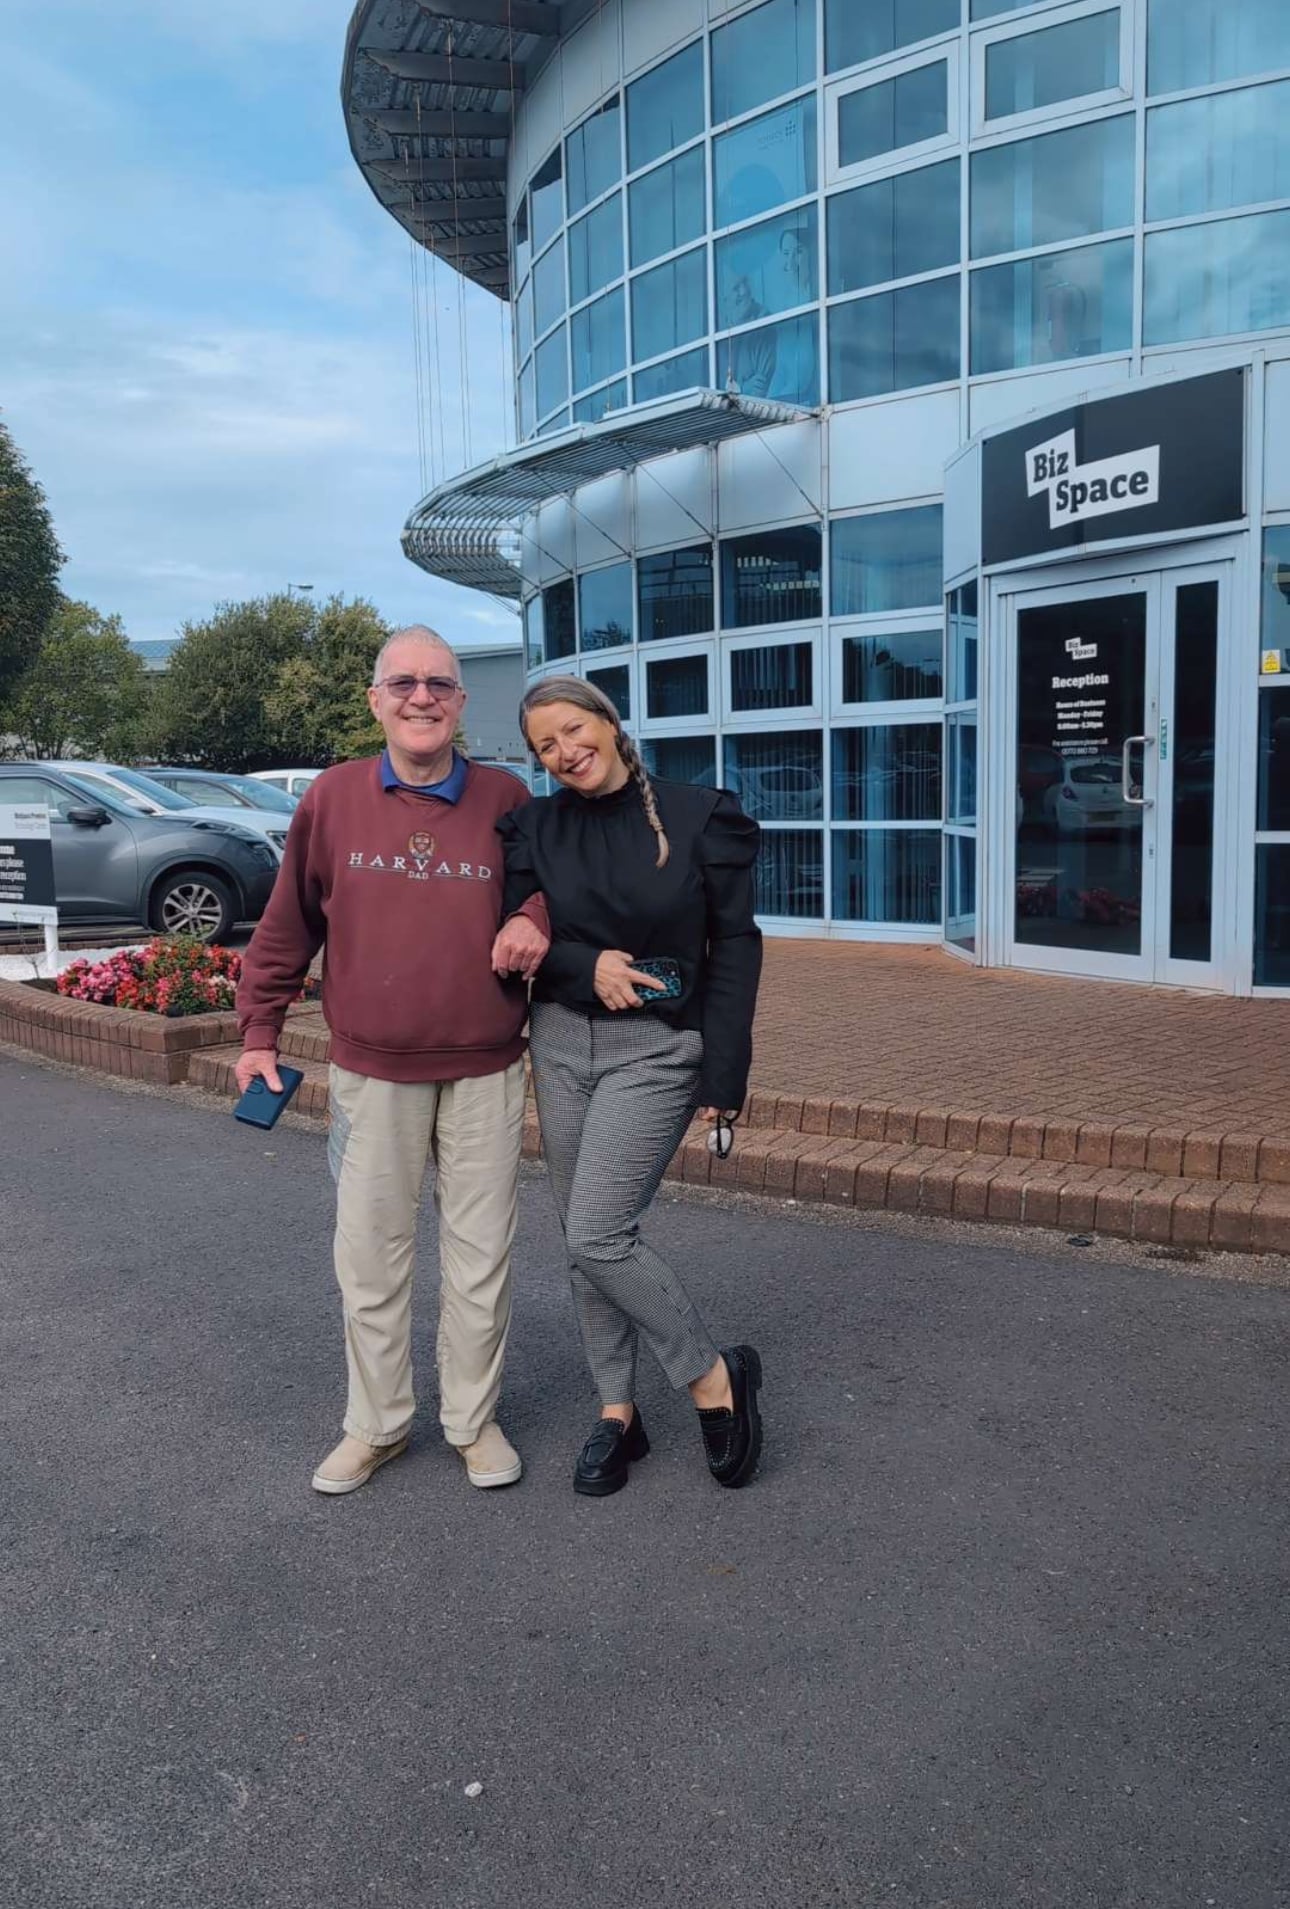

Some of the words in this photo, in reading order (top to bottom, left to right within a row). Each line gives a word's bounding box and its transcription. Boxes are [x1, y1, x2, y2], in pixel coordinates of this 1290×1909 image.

[1033, 448, 1069, 483] Biz
[1056, 470, 1149, 514] Space
[1052, 673, 1109, 689] Reception
[348, 852, 492, 879] HARVARD
[407, 870, 429, 880] DAD
